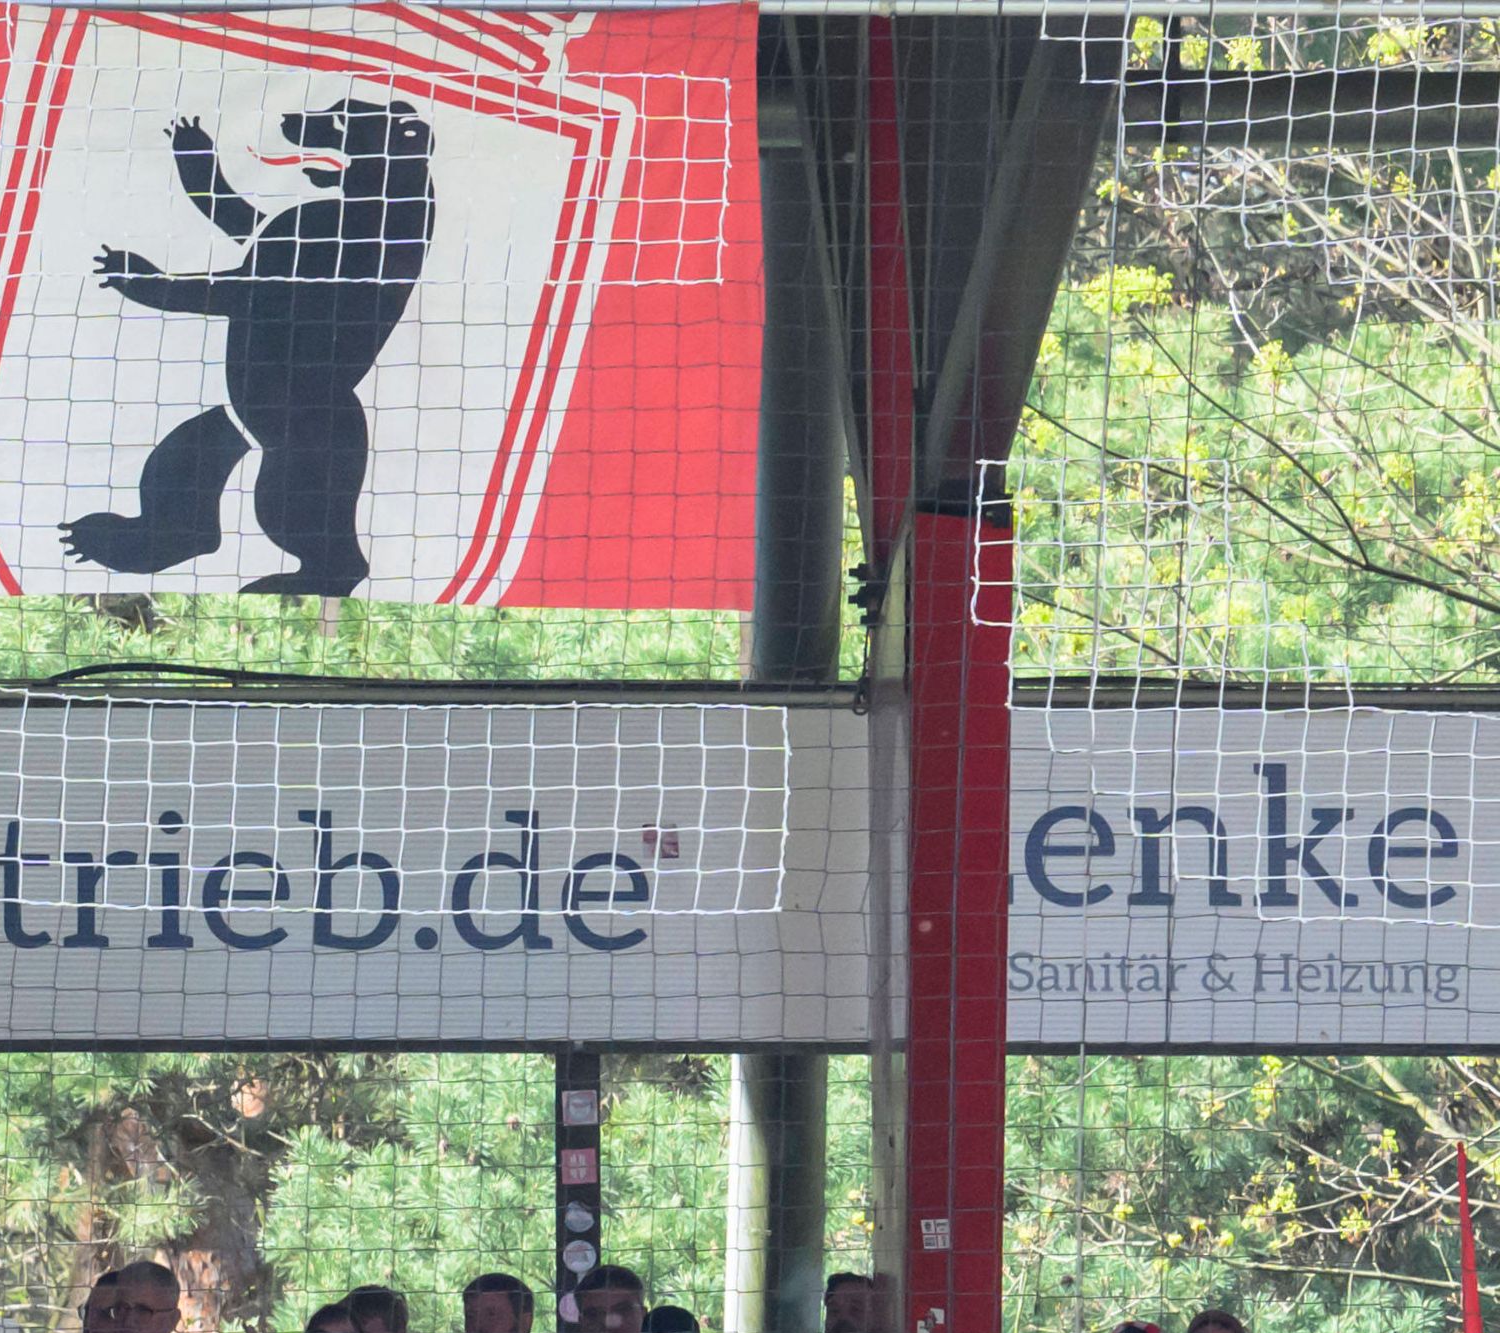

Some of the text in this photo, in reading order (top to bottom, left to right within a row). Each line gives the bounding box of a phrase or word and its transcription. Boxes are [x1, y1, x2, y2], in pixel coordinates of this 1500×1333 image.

[1009, 764, 1460, 909] enke
[1009, 951, 1186, 994] Sanitär
[1253, 952, 1461, 1003] Heizung
